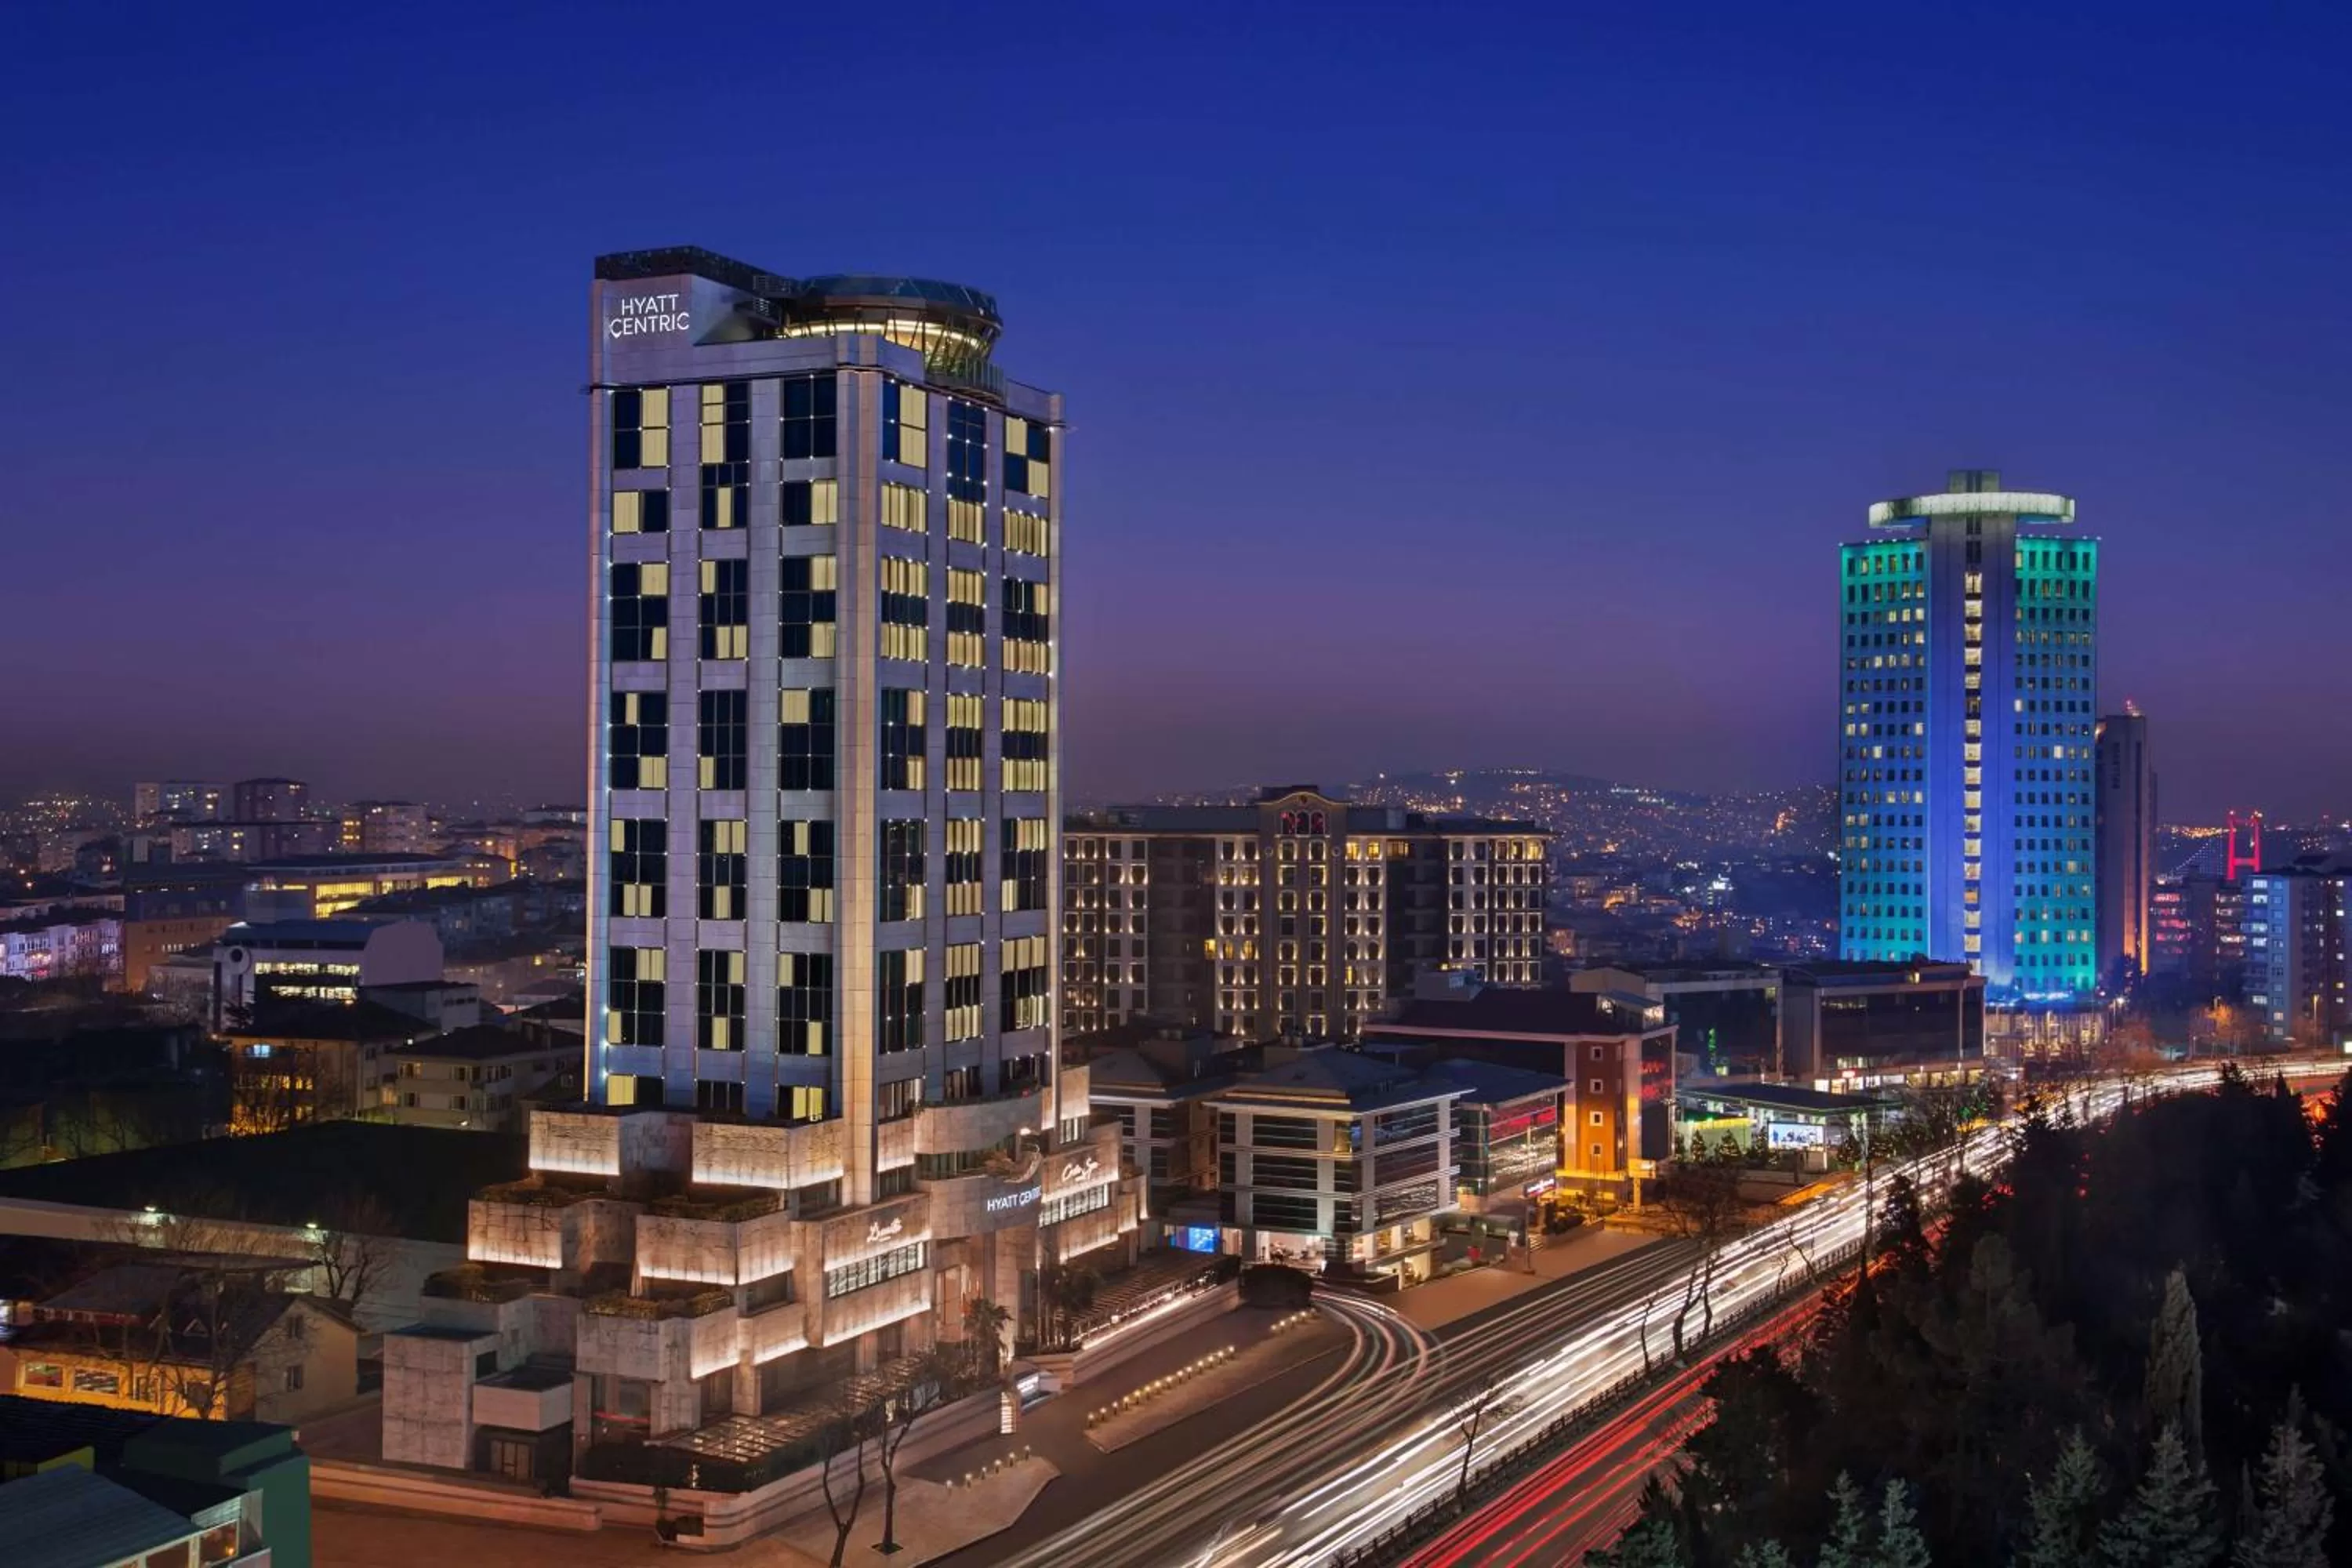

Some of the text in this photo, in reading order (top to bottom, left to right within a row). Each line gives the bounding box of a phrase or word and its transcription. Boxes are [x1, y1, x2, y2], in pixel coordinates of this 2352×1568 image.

[622, 293, 679, 316] HYATT
[609, 311, 690, 339] CENTRIC
[987, 1194, 1018, 1211] HYATT
